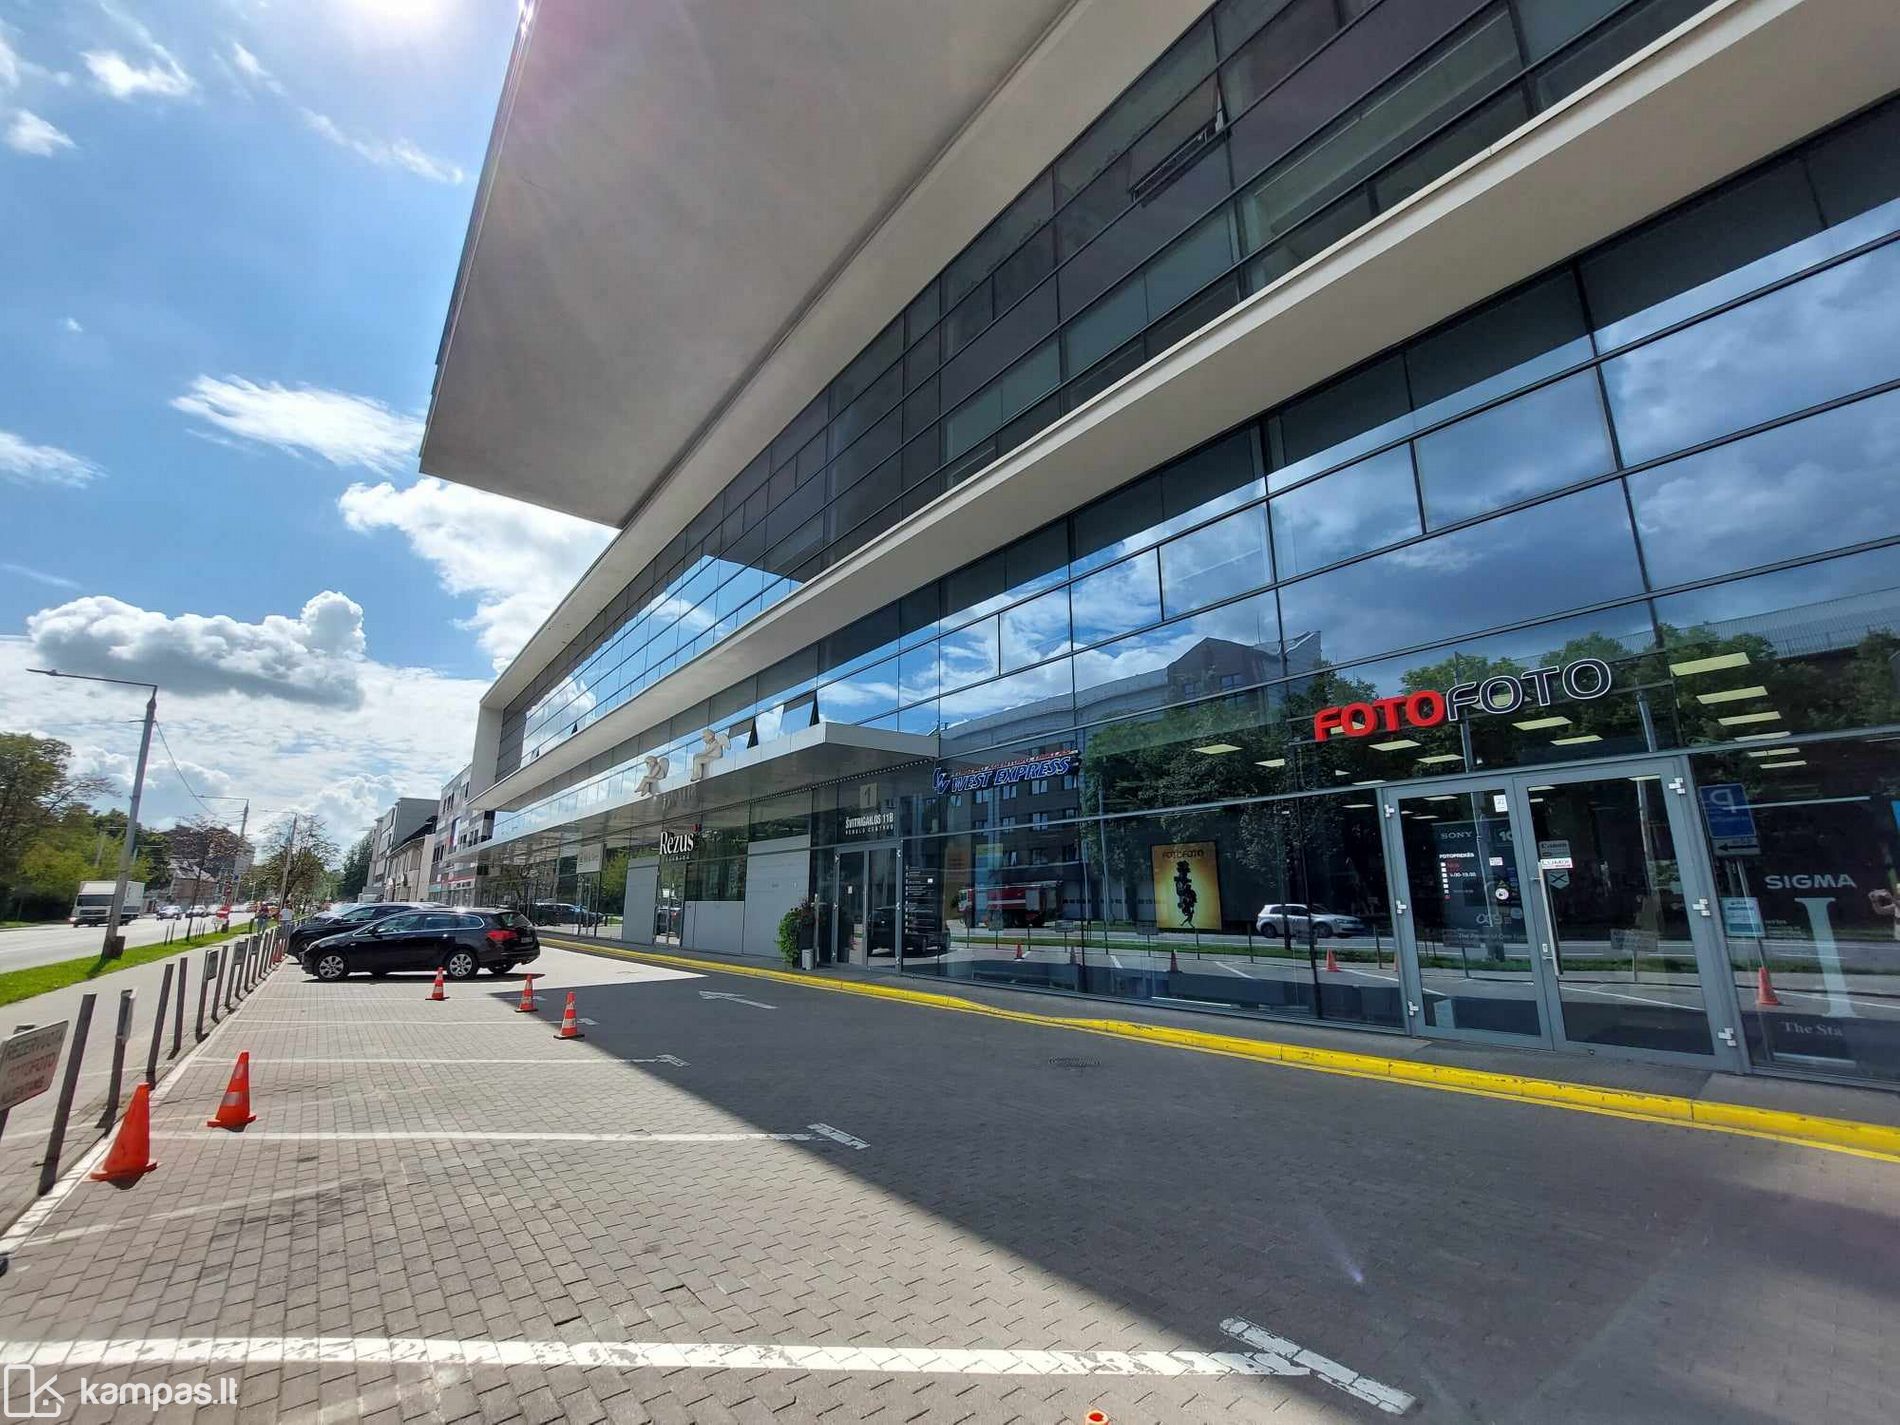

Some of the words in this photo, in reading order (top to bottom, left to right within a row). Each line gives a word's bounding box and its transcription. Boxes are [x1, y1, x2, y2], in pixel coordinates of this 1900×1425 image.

[951, 771, 993, 793] WEST
[994, 756, 1071, 785] EXPRESS
[882, 812, 894, 824] 11B
[659, 831, 694, 855] Rezus
[1440, 831, 1473, 840] SONY
[1764, 872, 1857, 890] SIGMA
[1782, 1021, 1813, 1035] The
